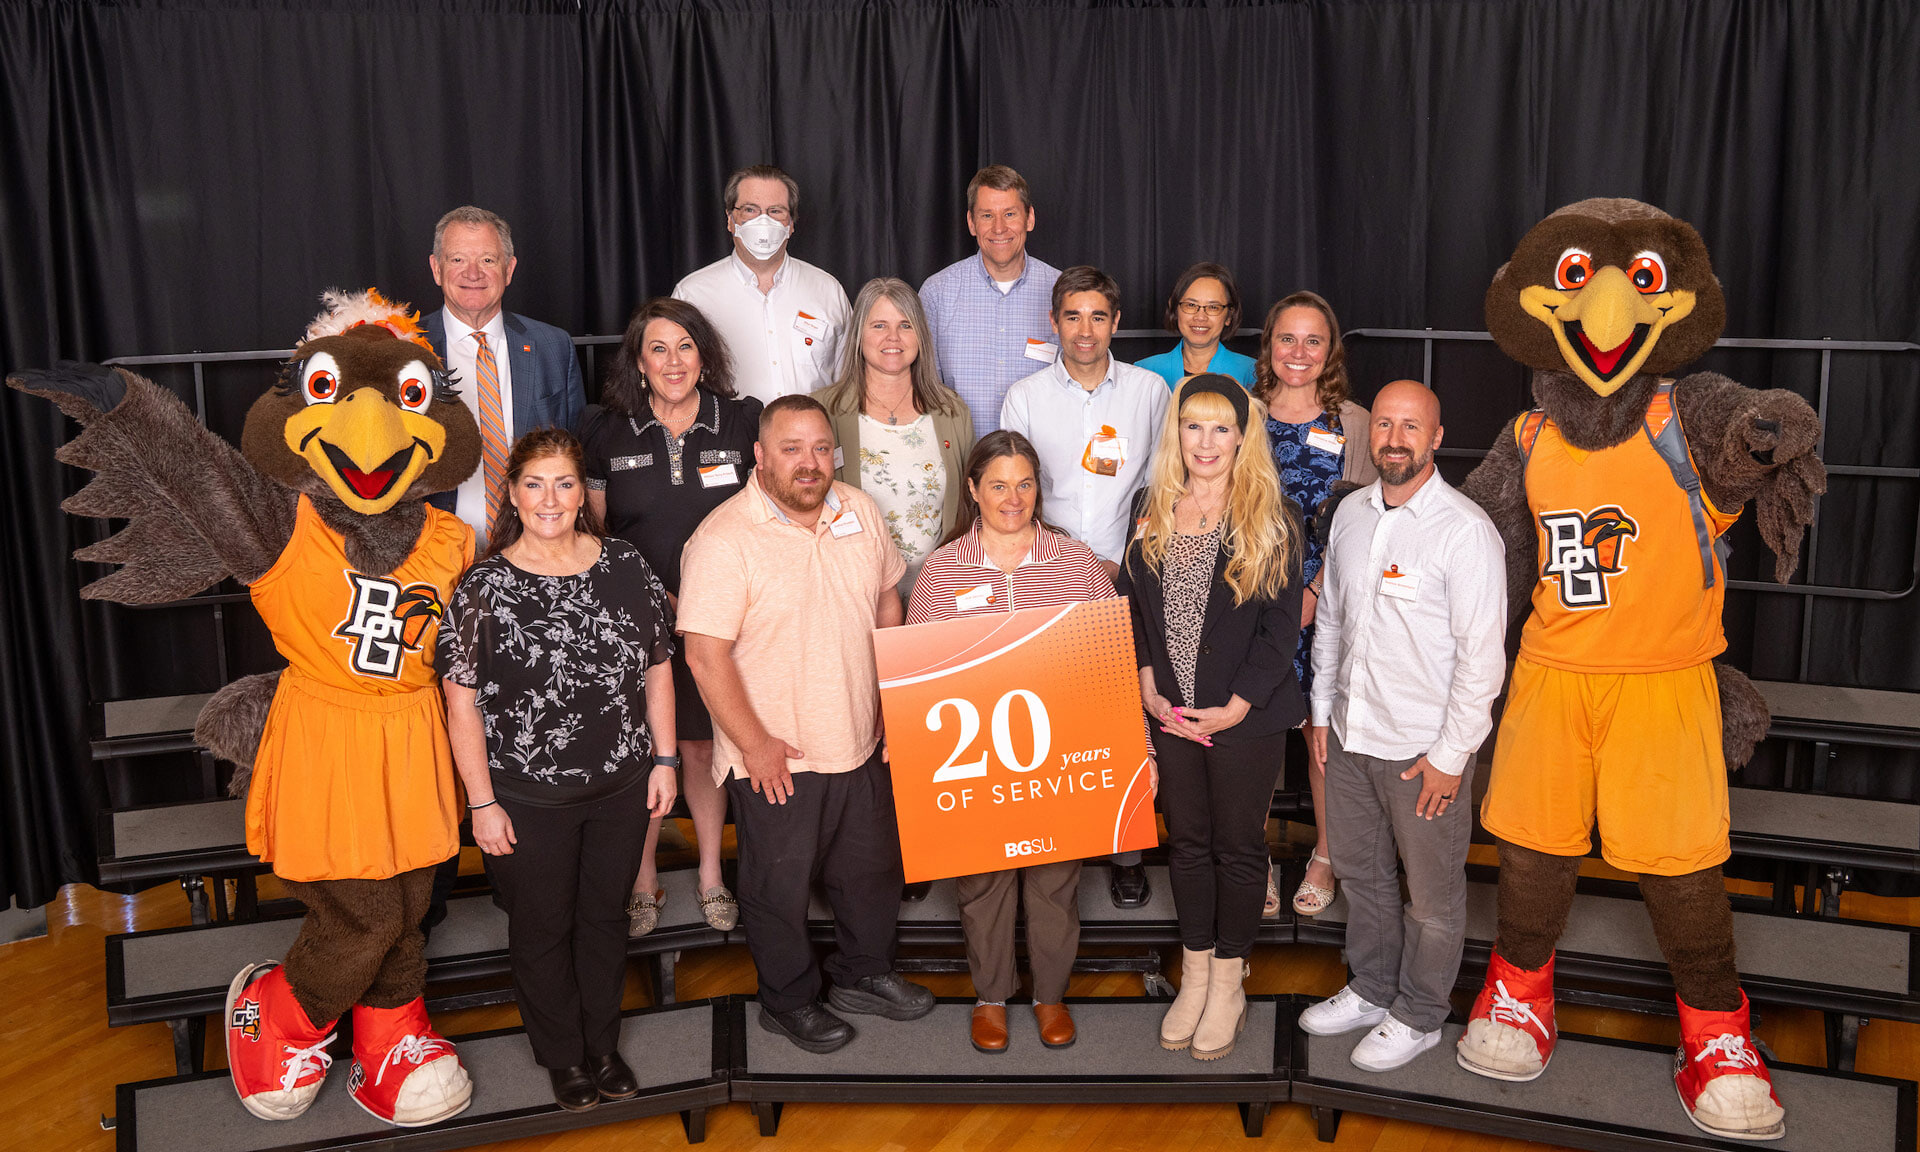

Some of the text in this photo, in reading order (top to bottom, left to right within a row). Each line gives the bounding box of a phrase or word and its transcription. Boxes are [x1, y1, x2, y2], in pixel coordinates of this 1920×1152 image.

[925, 689, 1051, 783] 20
[1060, 747, 1111, 770] years
[936, 768, 1115, 812] OF SERVICE
